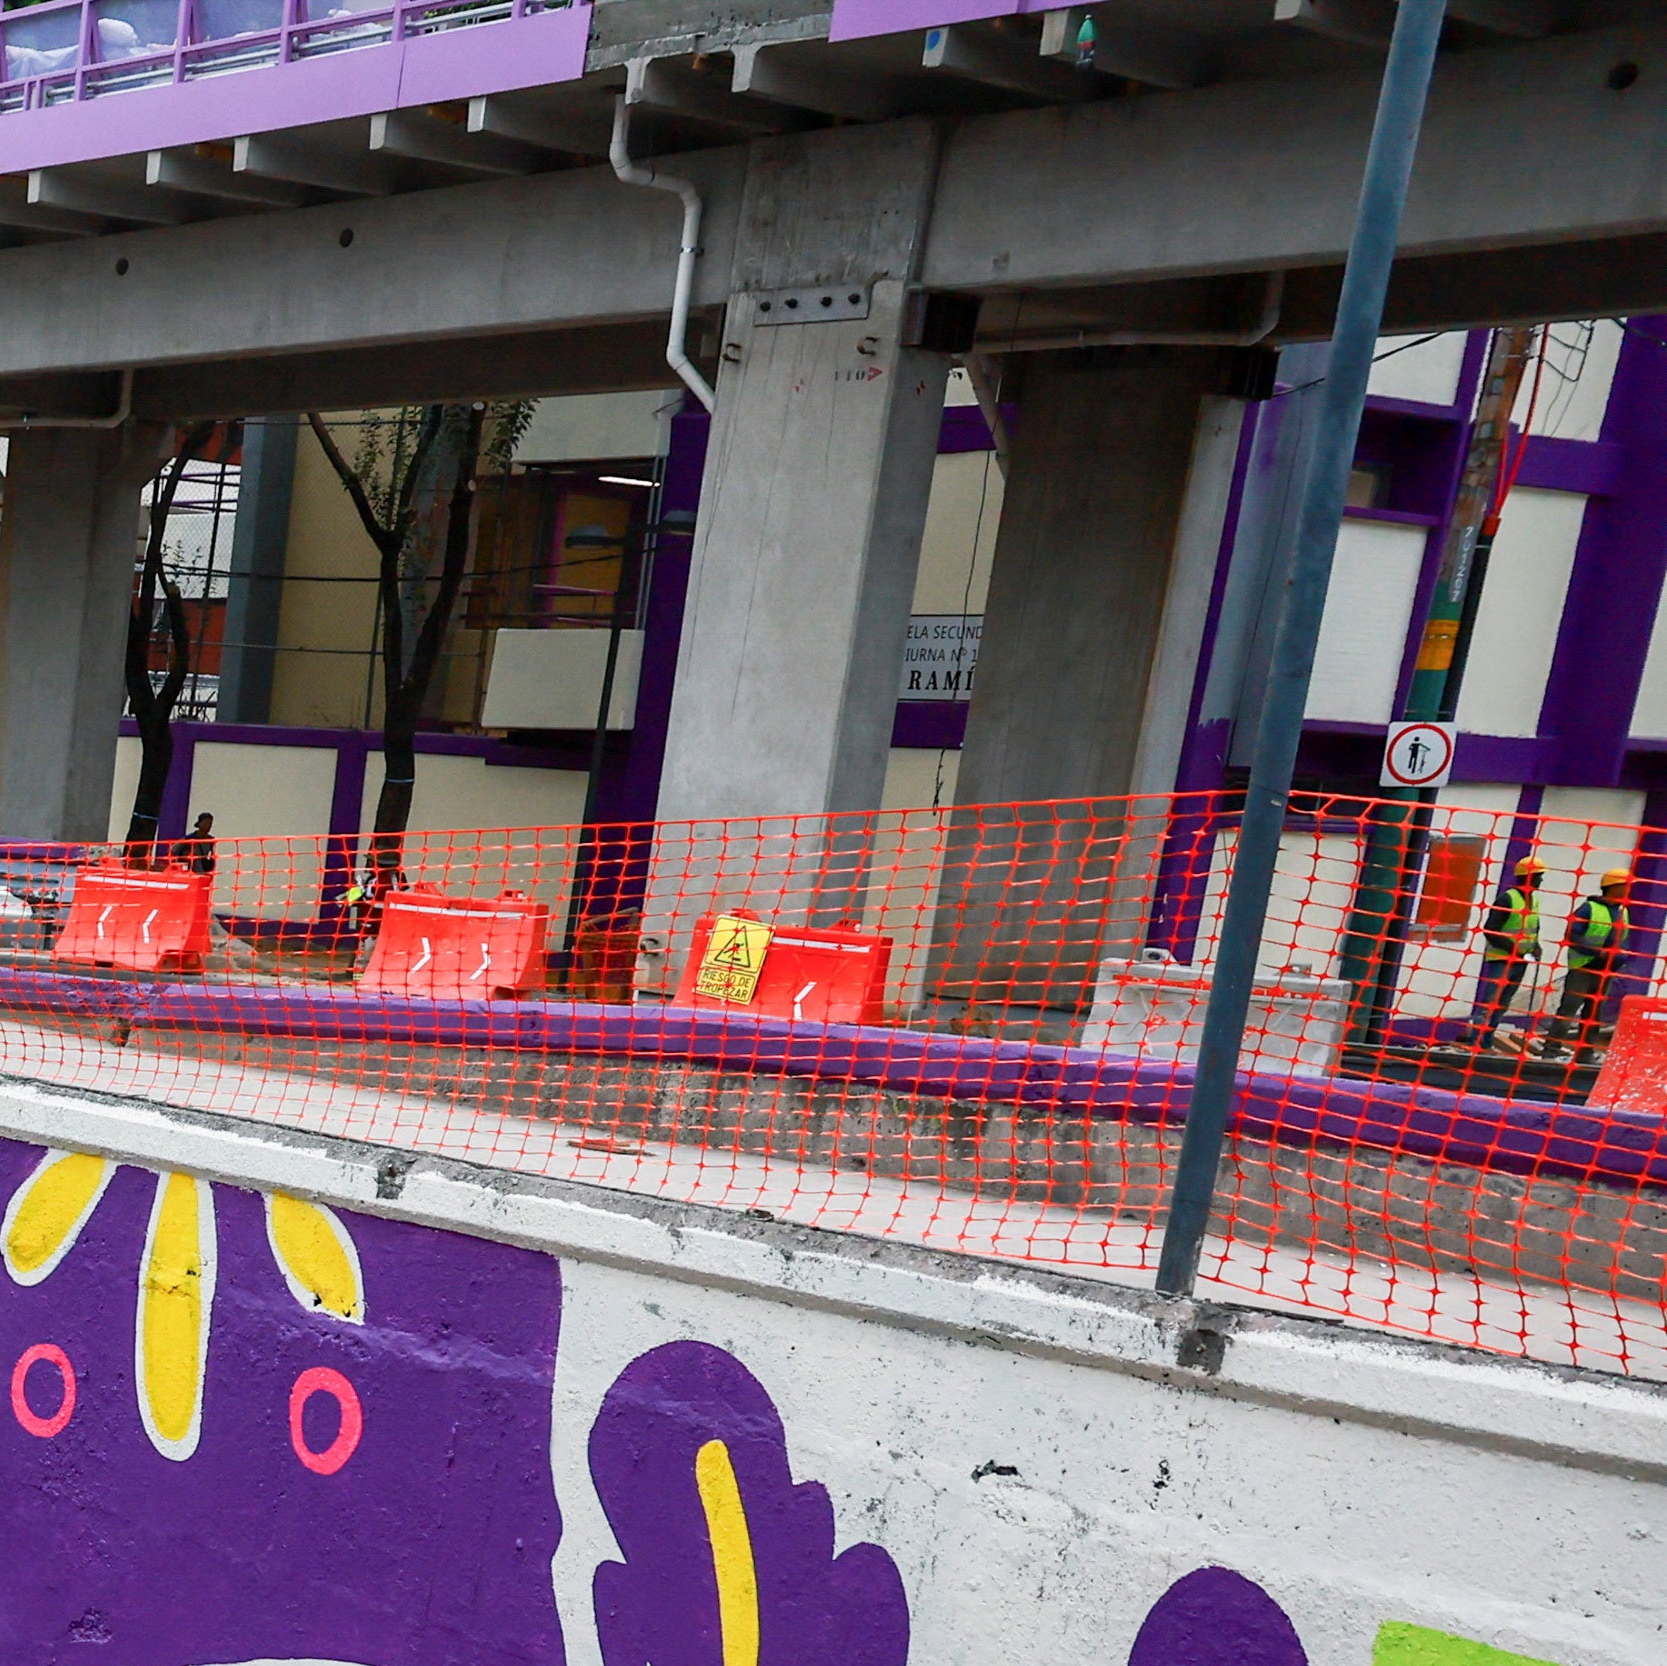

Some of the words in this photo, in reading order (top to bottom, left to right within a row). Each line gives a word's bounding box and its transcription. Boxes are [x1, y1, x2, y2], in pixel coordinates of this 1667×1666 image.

[907, 625, 928, 639] ELA
[703, 968, 737, 984] RIESGO
[739, 977, 752, 988] DE
